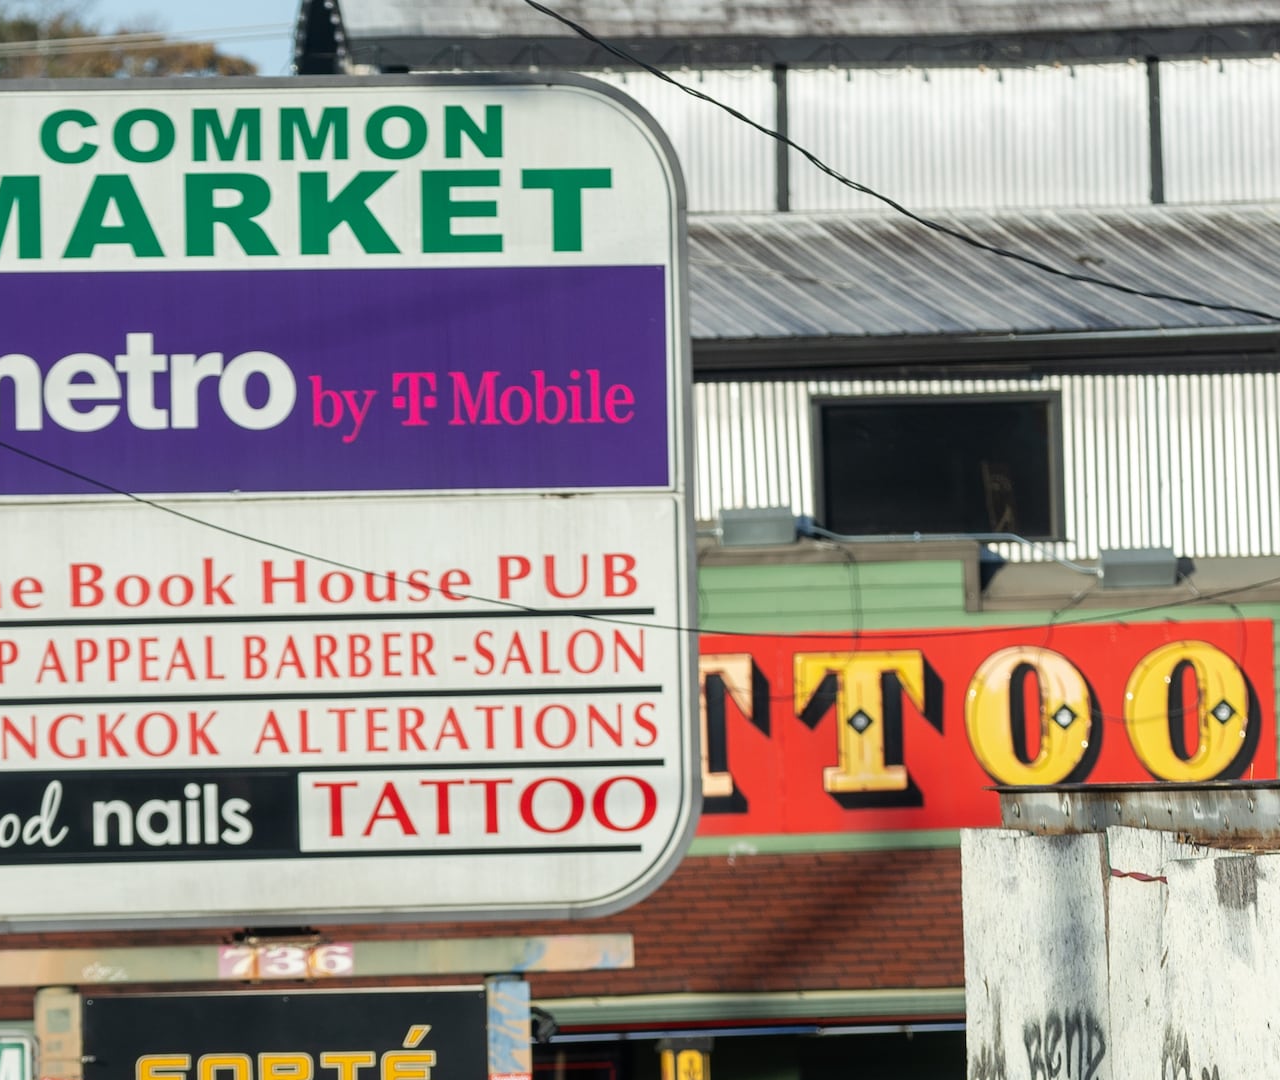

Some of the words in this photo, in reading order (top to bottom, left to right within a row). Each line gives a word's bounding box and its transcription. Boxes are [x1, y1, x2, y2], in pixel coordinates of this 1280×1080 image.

[39, 104, 504, 165] COMMON
[308, 375, 377, 443] by
[448, 368, 635, 426] Mobile
[69, 558, 236, 609] Book
[261, 560, 472, 605] House
[497, 553, 639, 600] PUB
[36, 635, 224, 684] APPEAL
[242, 632, 437, 680] BARBER
[254, 702, 659, 755] ALTERATIONS
[93, 783, 253, 847] nails
[313, 776, 659, 838] TATTOO
[223, 945, 354, 977] 736
